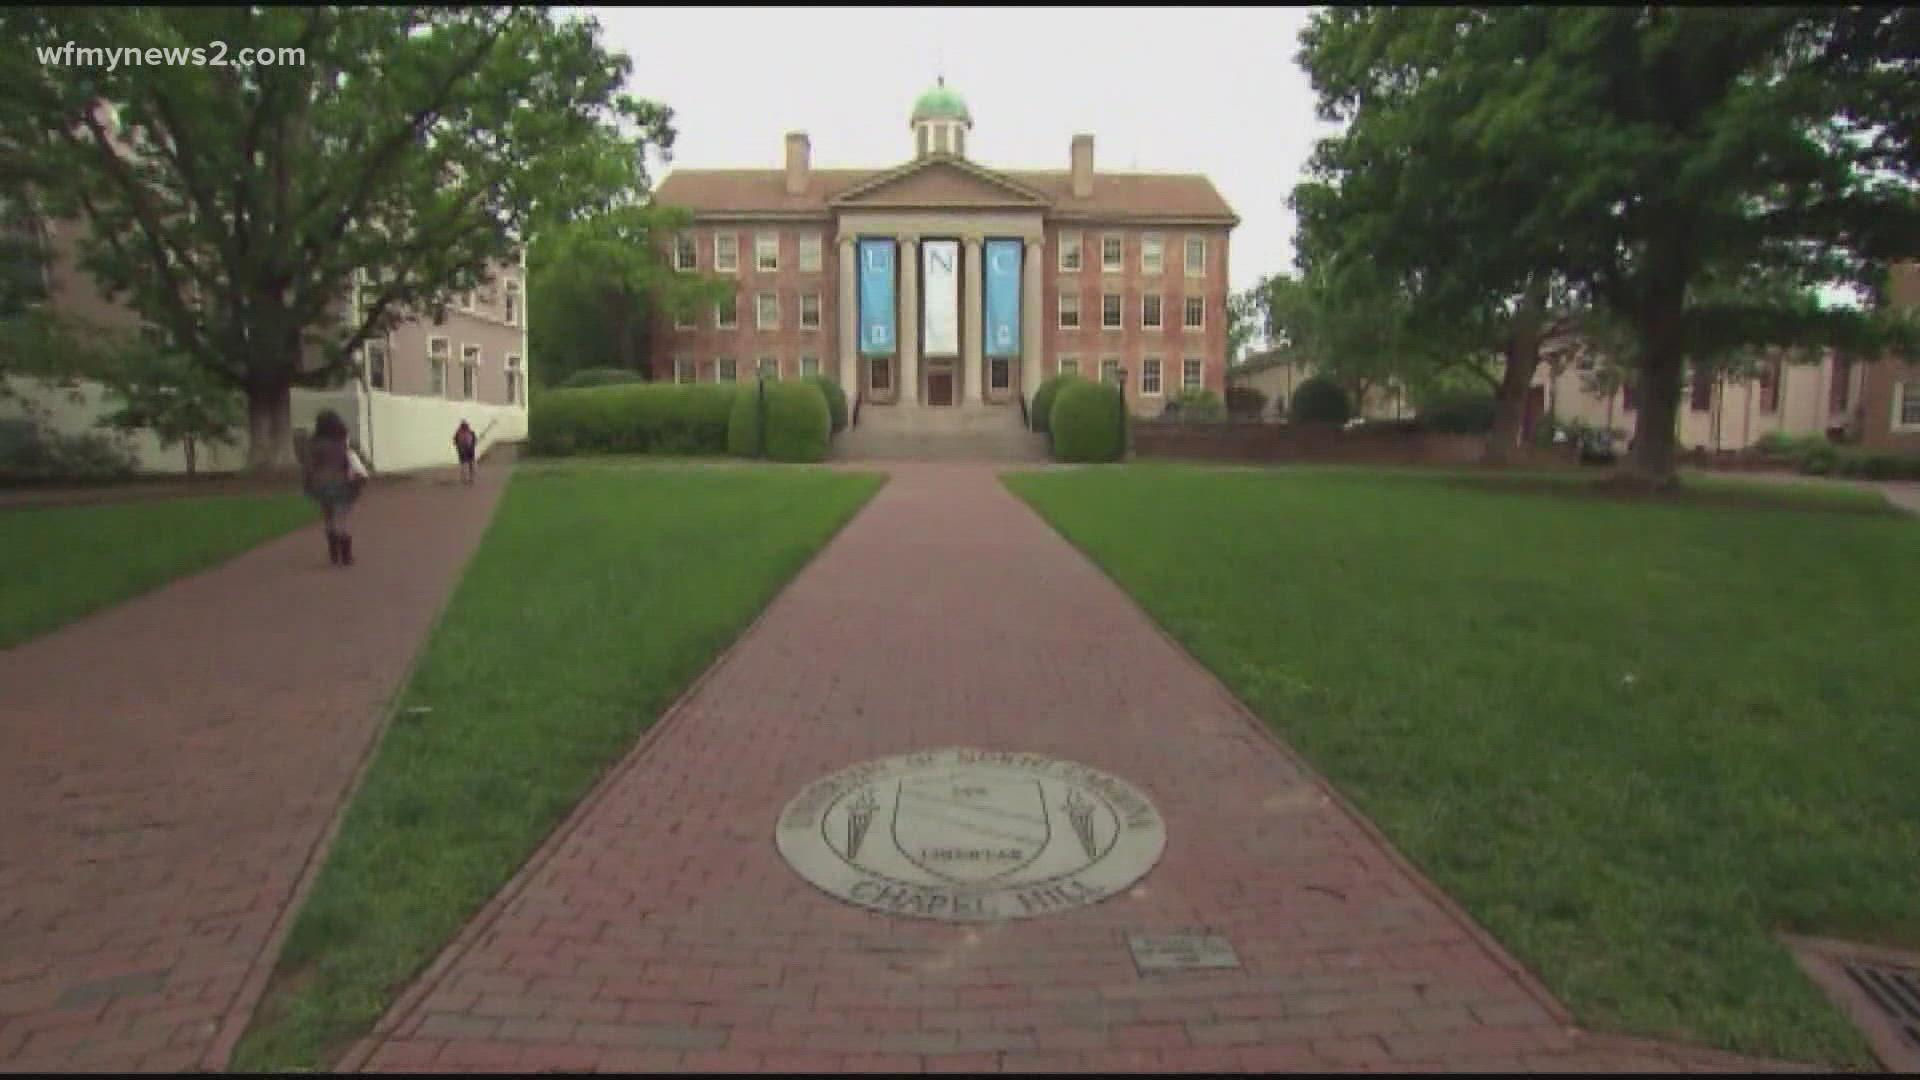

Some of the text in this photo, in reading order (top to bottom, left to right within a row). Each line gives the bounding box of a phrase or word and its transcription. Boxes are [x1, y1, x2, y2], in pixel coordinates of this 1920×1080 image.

[928, 248, 953, 273] N
[991, 247, 1015, 273] C
[850, 880, 1106, 915] CHAPEL HILL
